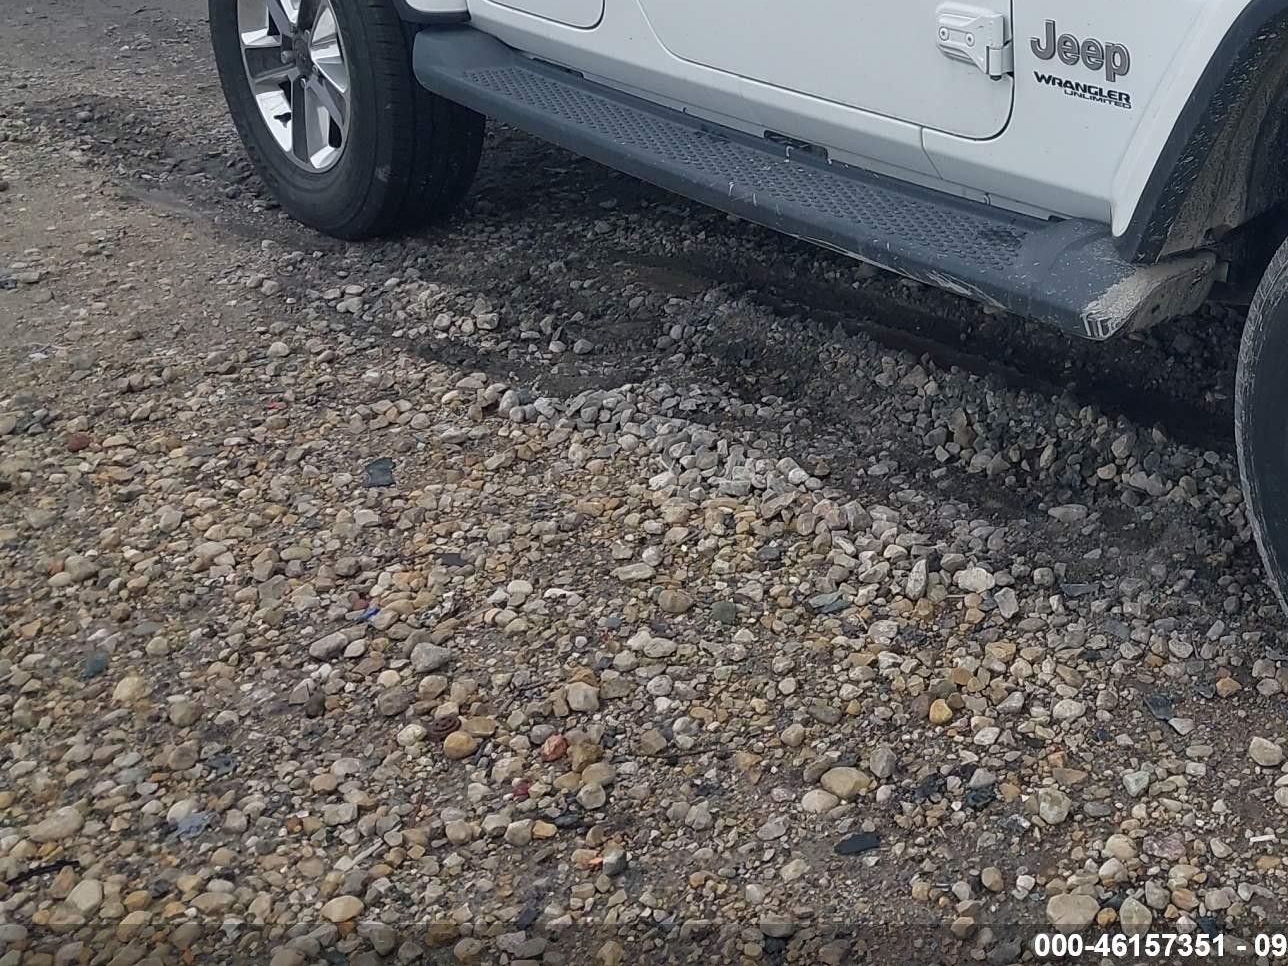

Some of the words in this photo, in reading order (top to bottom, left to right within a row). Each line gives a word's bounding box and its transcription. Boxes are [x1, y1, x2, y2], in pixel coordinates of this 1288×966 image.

[1030, 18, 1131, 82] Jeep
[1033, 71, 1132, 103] WRANGLER
[1063, 88, 1132, 109] UNLIMITED
